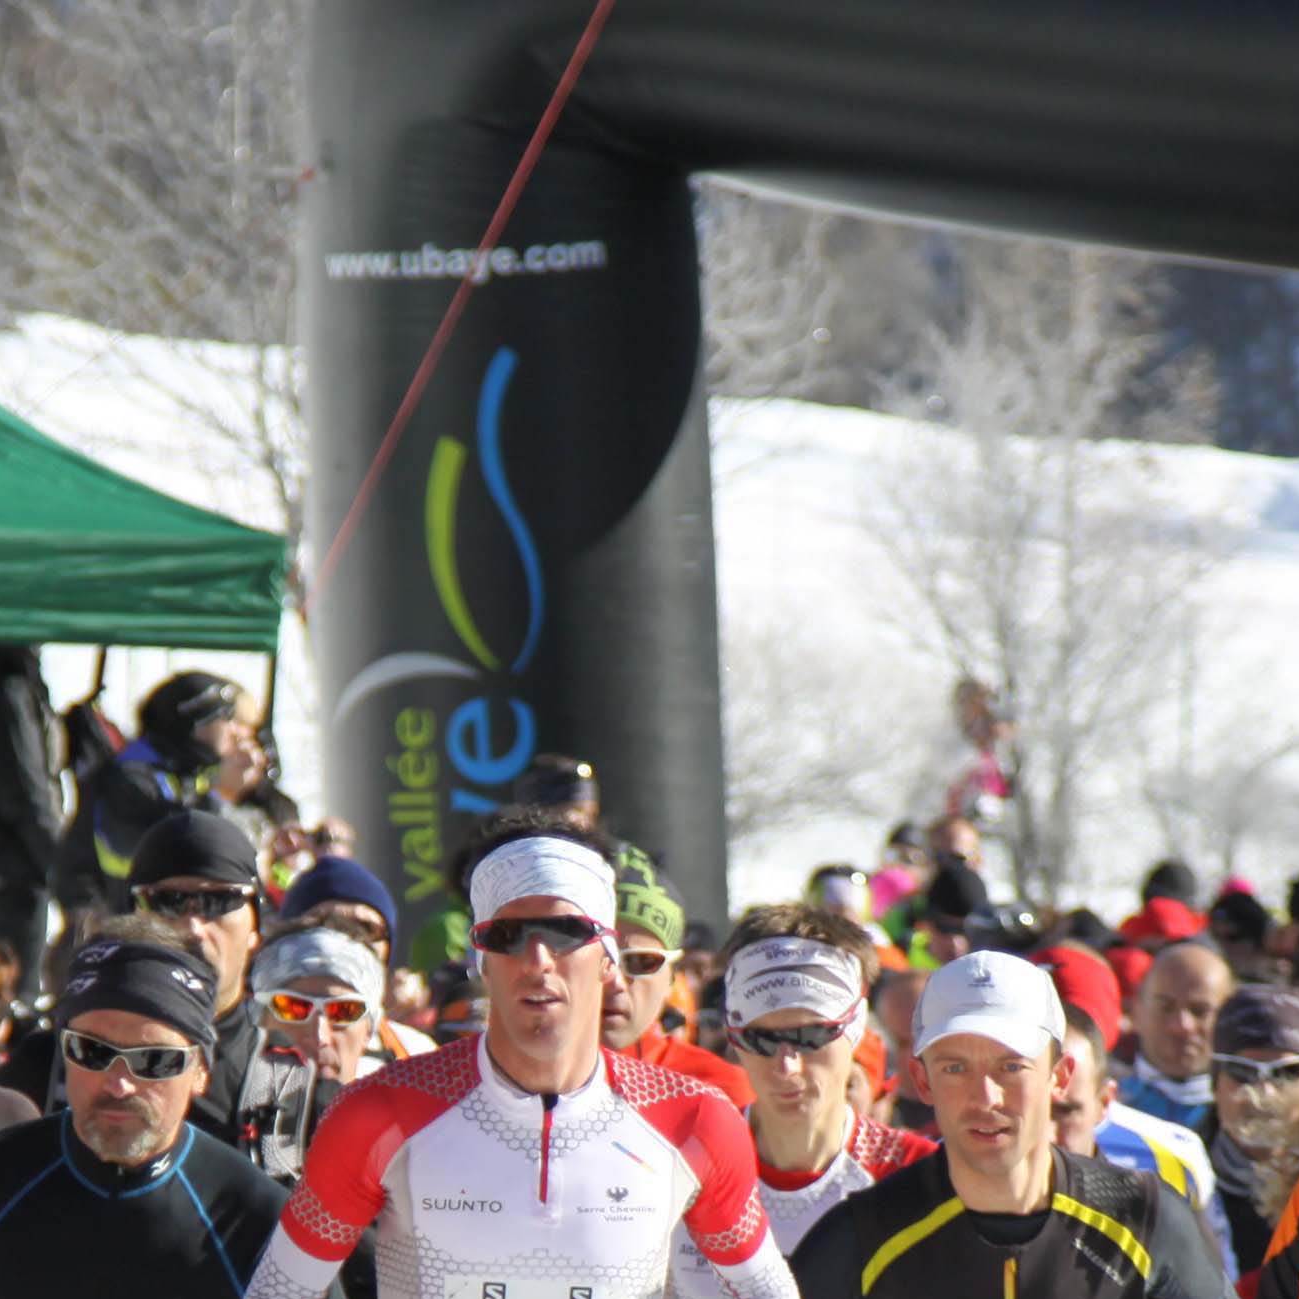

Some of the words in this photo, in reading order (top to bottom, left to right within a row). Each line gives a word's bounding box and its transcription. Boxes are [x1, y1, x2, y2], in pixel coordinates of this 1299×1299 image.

[325, 241, 607, 284] www.ubaye.com
[385, 706, 443, 901] vallée
[421, 1197, 503, 1214] SUUNTO
